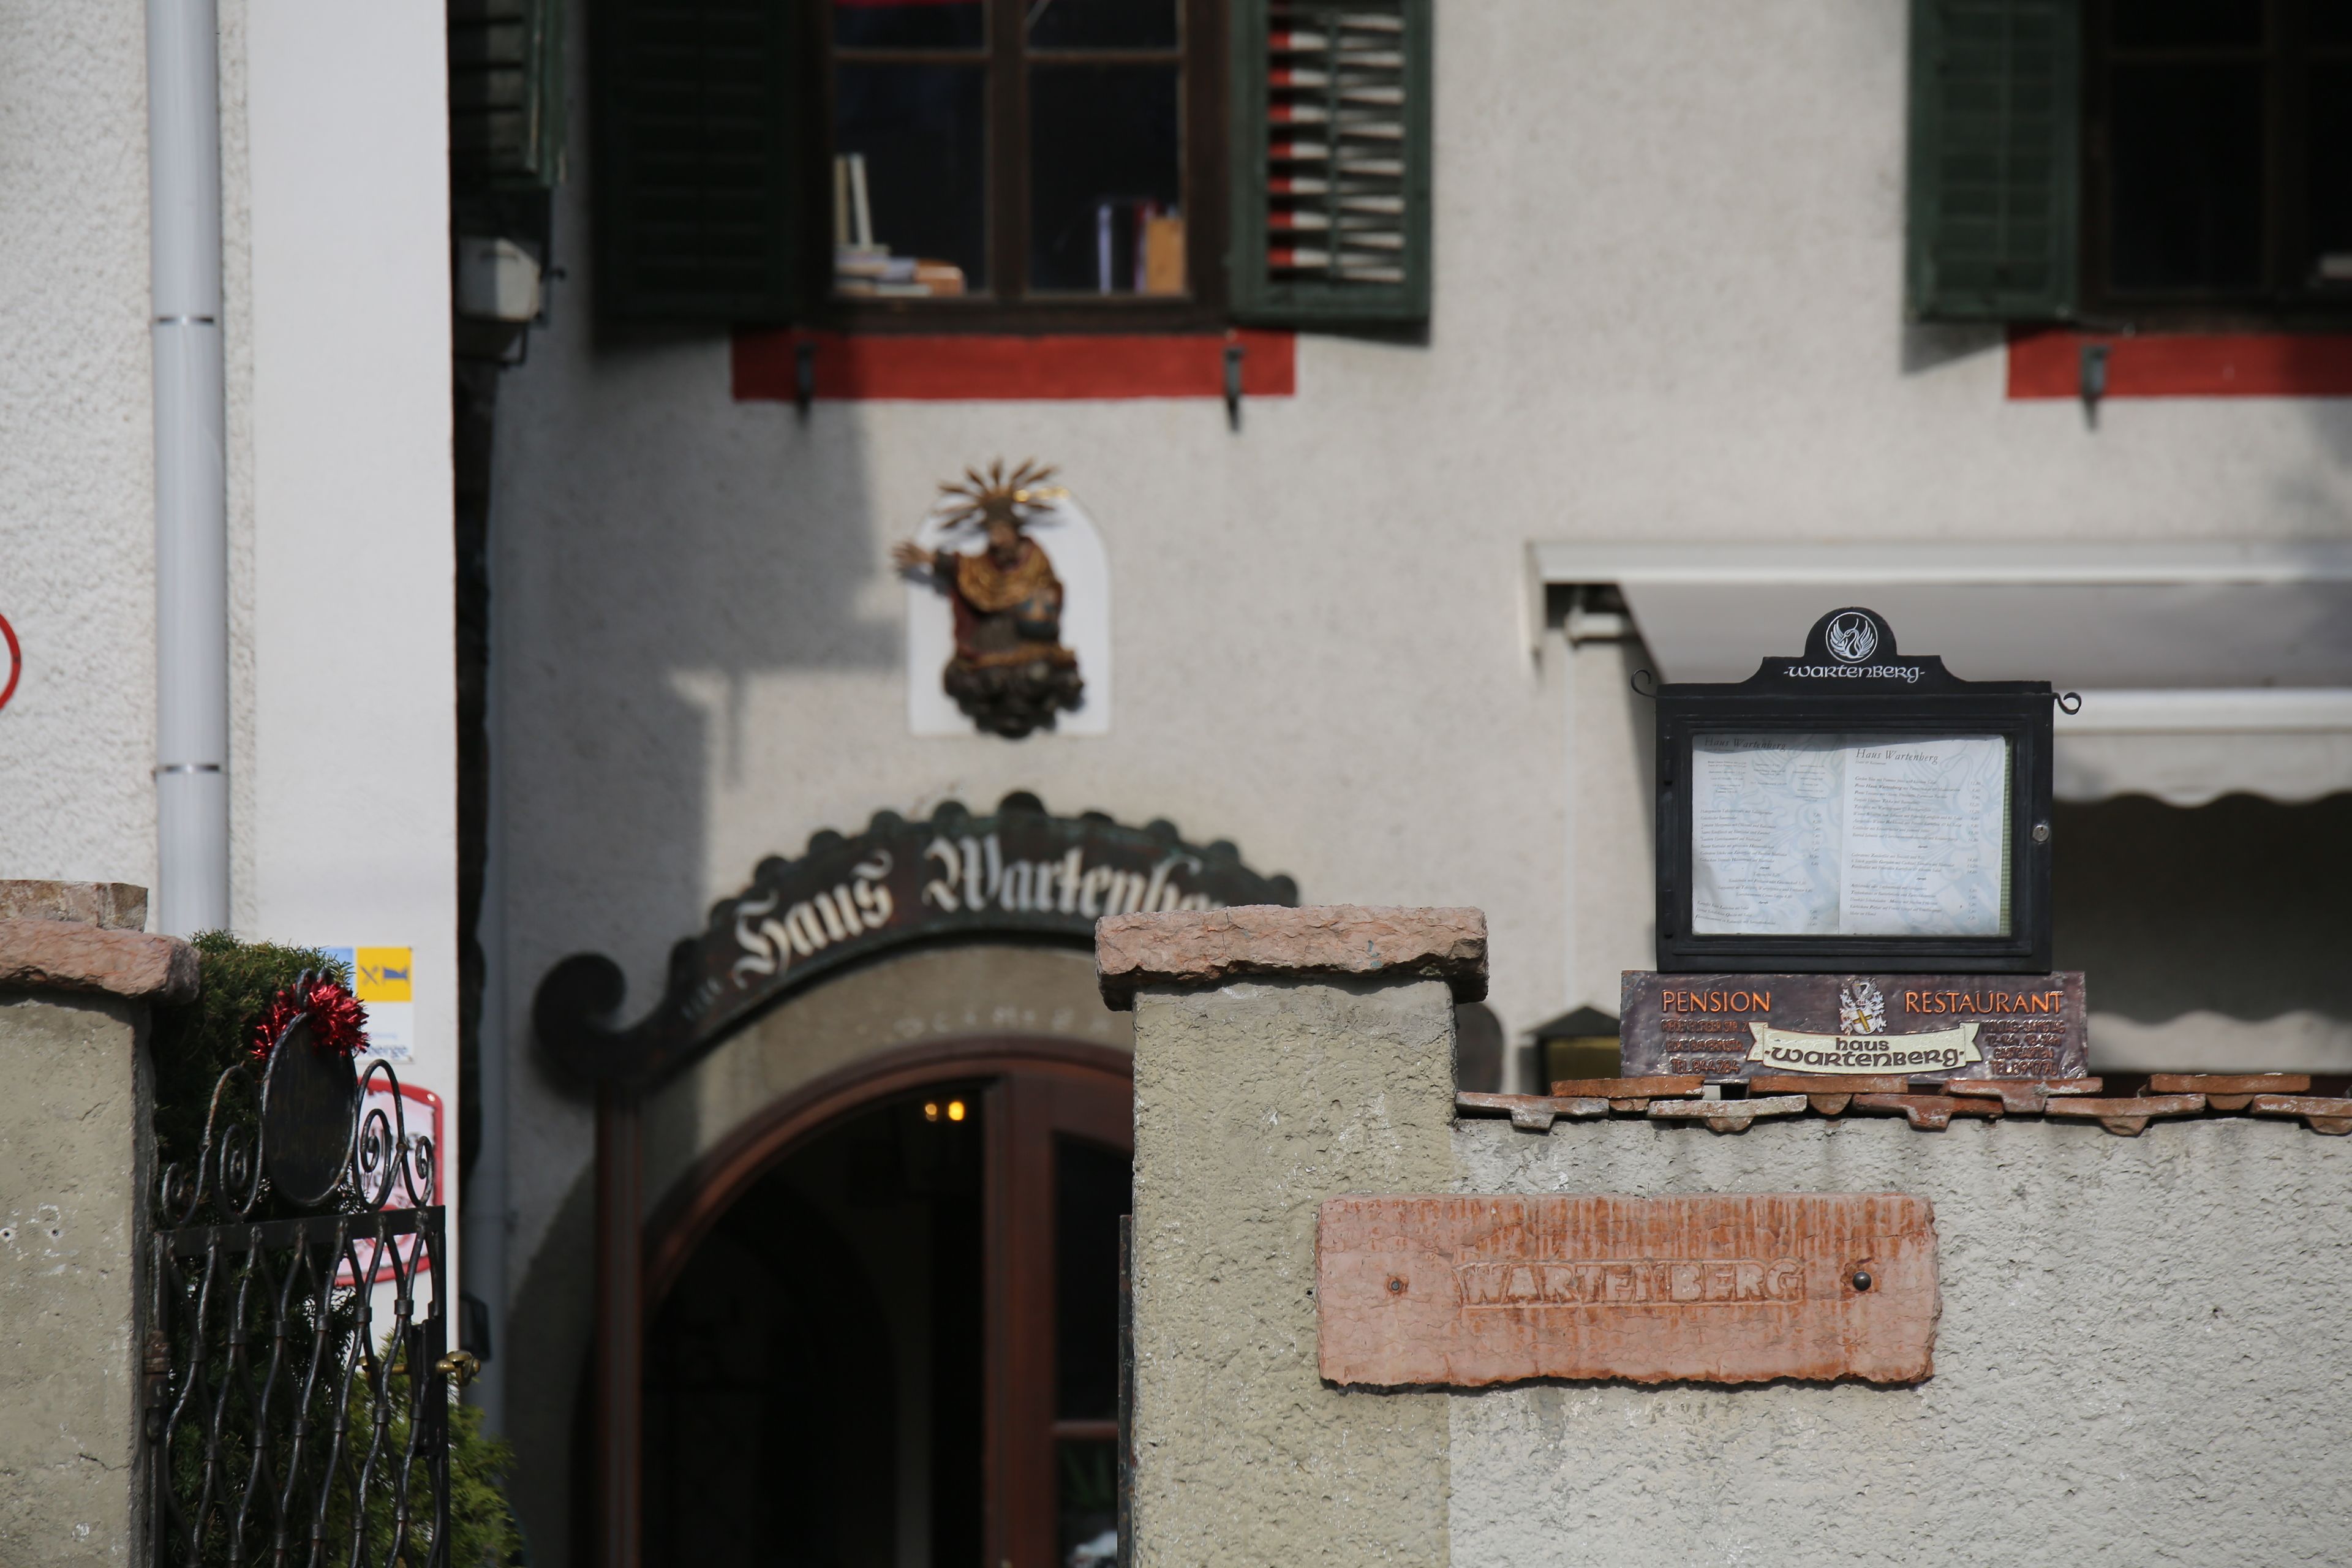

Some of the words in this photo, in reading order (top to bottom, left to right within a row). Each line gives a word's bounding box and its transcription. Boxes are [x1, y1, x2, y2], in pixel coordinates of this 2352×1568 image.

[1856, 748, 1882, 759] Haus
[1885, 750, 1939, 765] Wartenberg
[735, 848, 893, 987] Haus
[1662, 990, 1771, 1012] PENSION
[1904, 990, 2064, 1014] RESTAURANT
[1836, 1037, 1889, 1051] haus
[1451, 1256, 1807, 1306] WARTENBERG
